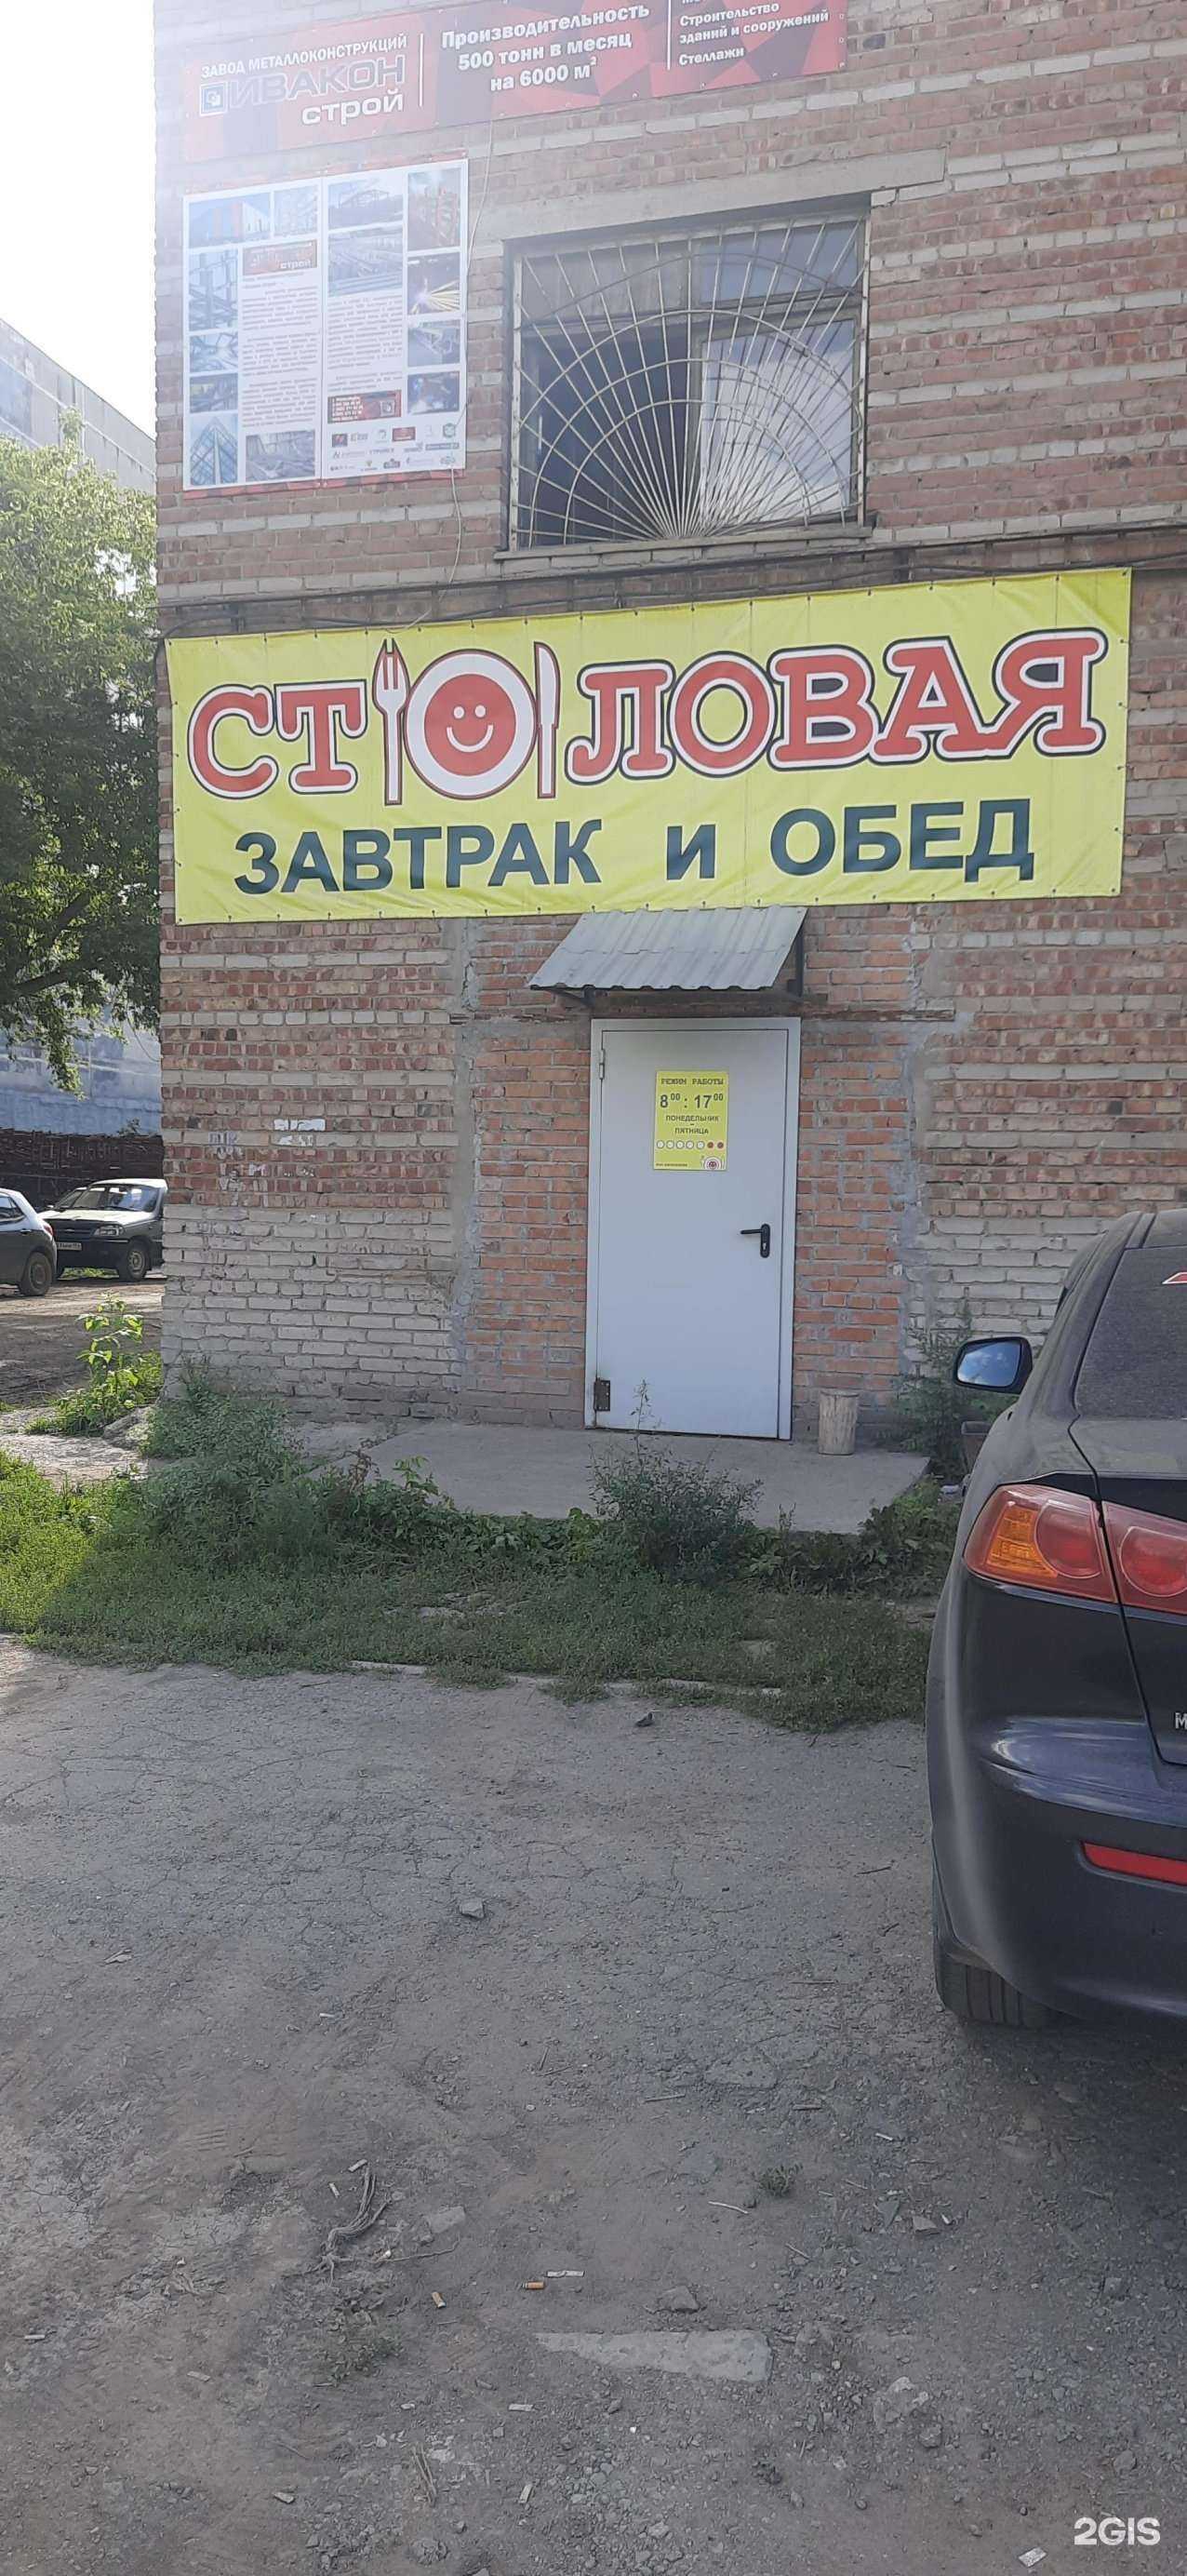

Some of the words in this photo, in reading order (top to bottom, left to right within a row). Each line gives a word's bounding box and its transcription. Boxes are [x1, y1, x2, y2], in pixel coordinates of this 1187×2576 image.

[442, 5, 649, 49] Производительность
[680, 3, 780, 27] Строительство
[680, 26, 727, 45] зданий
[731, 27, 740, 36] и
[743, 9, 830, 34] сооружений
[201, 60, 246, 78] ЗАВОД
[248, 33, 407, 72] МЕТАЛЛОКОНСТРУКЦИЙ
[458, 50, 494, 71] 500
[499, 45, 544, 65] тонн
[550, 43, 562, 58] в
[567, 33, 633, 56] месяц
[679, 47, 744, 66] Стеллажи
[490, 76, 514, 91] на
[519, 63, 569, 87] 6000
[301, 88, 404, 126] строй
[233, 819, 603, 894] ЗАВТРАК
[769, 798, 1034, 883] ОБЕД
